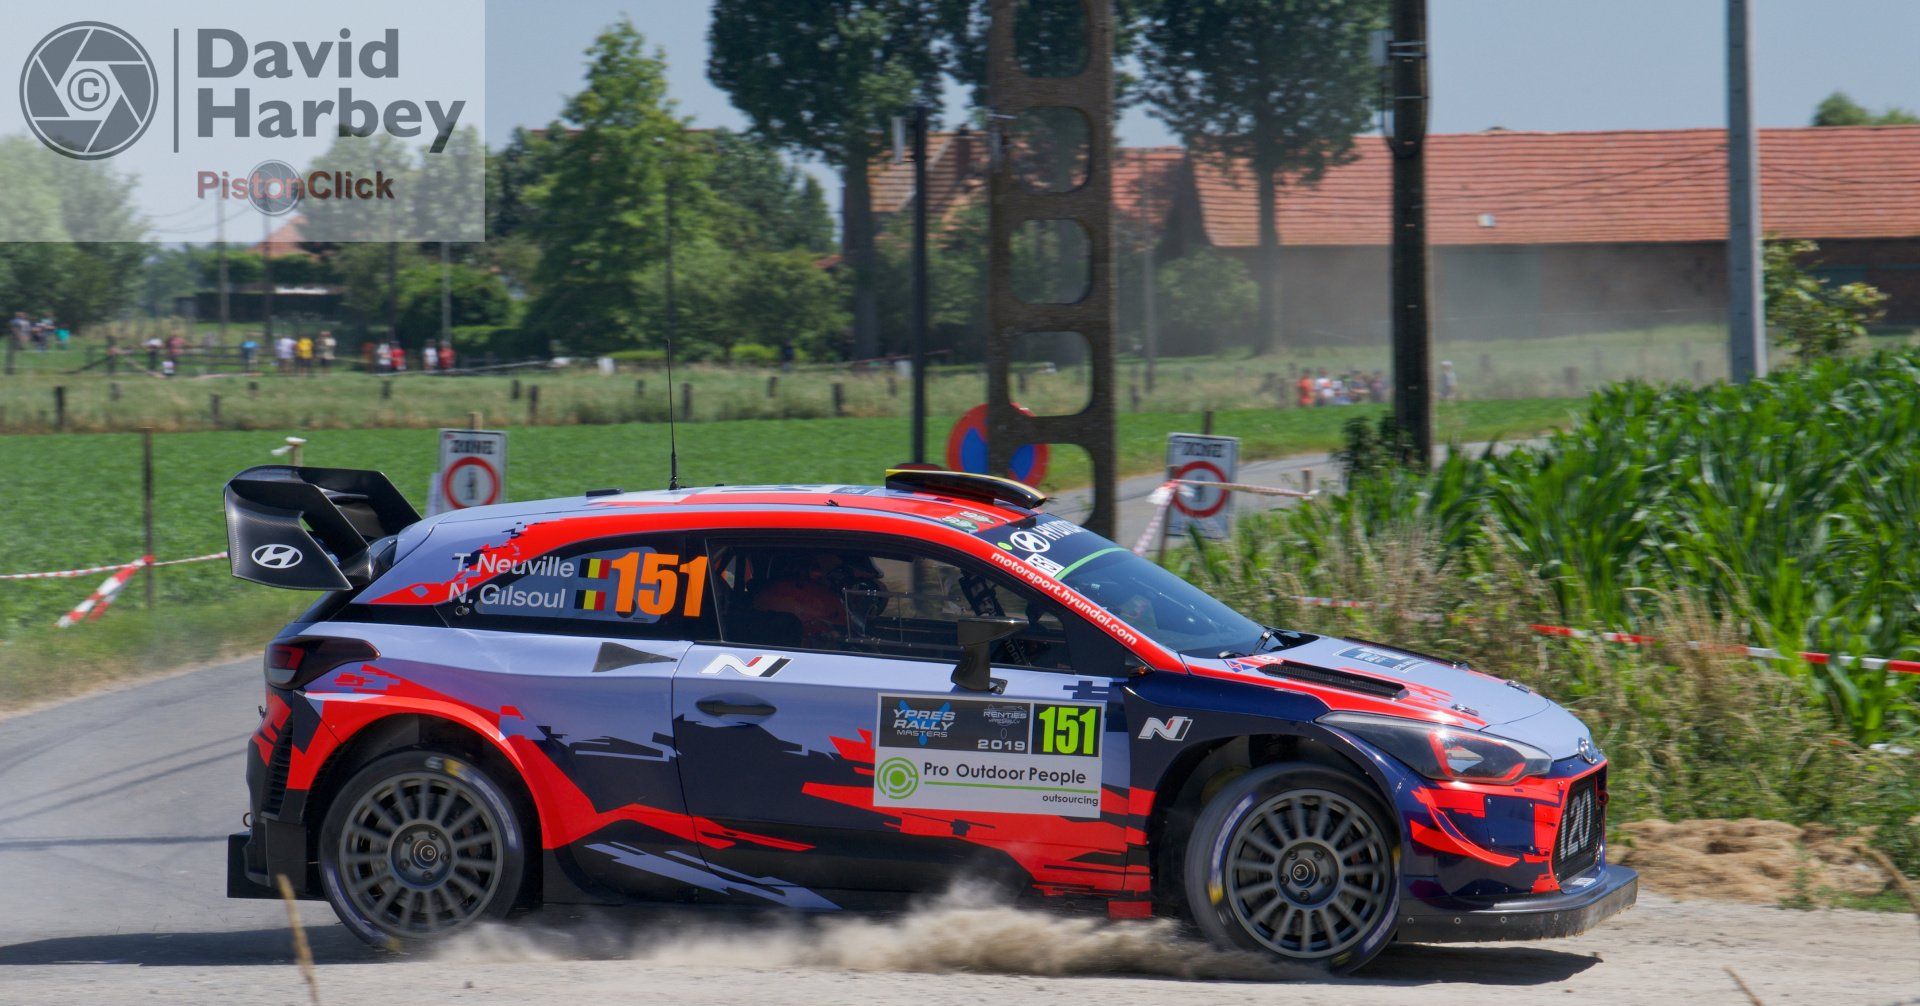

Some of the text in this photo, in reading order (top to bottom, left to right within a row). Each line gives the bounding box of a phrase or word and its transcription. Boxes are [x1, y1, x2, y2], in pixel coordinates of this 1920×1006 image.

[452, 552, 575, 578] T. Neuville
[449, 582, 566, 609] N. Gilsoul
[611, 551, 708, 617] 151
[991, 552, 1137, 646] motorsport.hyundai.com
[893, 708, 956, 721] YPRES
[893, 719, 955, 731] RALLY
[896, 729, 948, 738] MASTERS
[1039, 706, 1096, 755] 151
[977, 739, 1026, 751] 2019
[924, 762, 1086, 786] Pro Outdoor People
[1042, 793, 1099, 807] outsourcing
